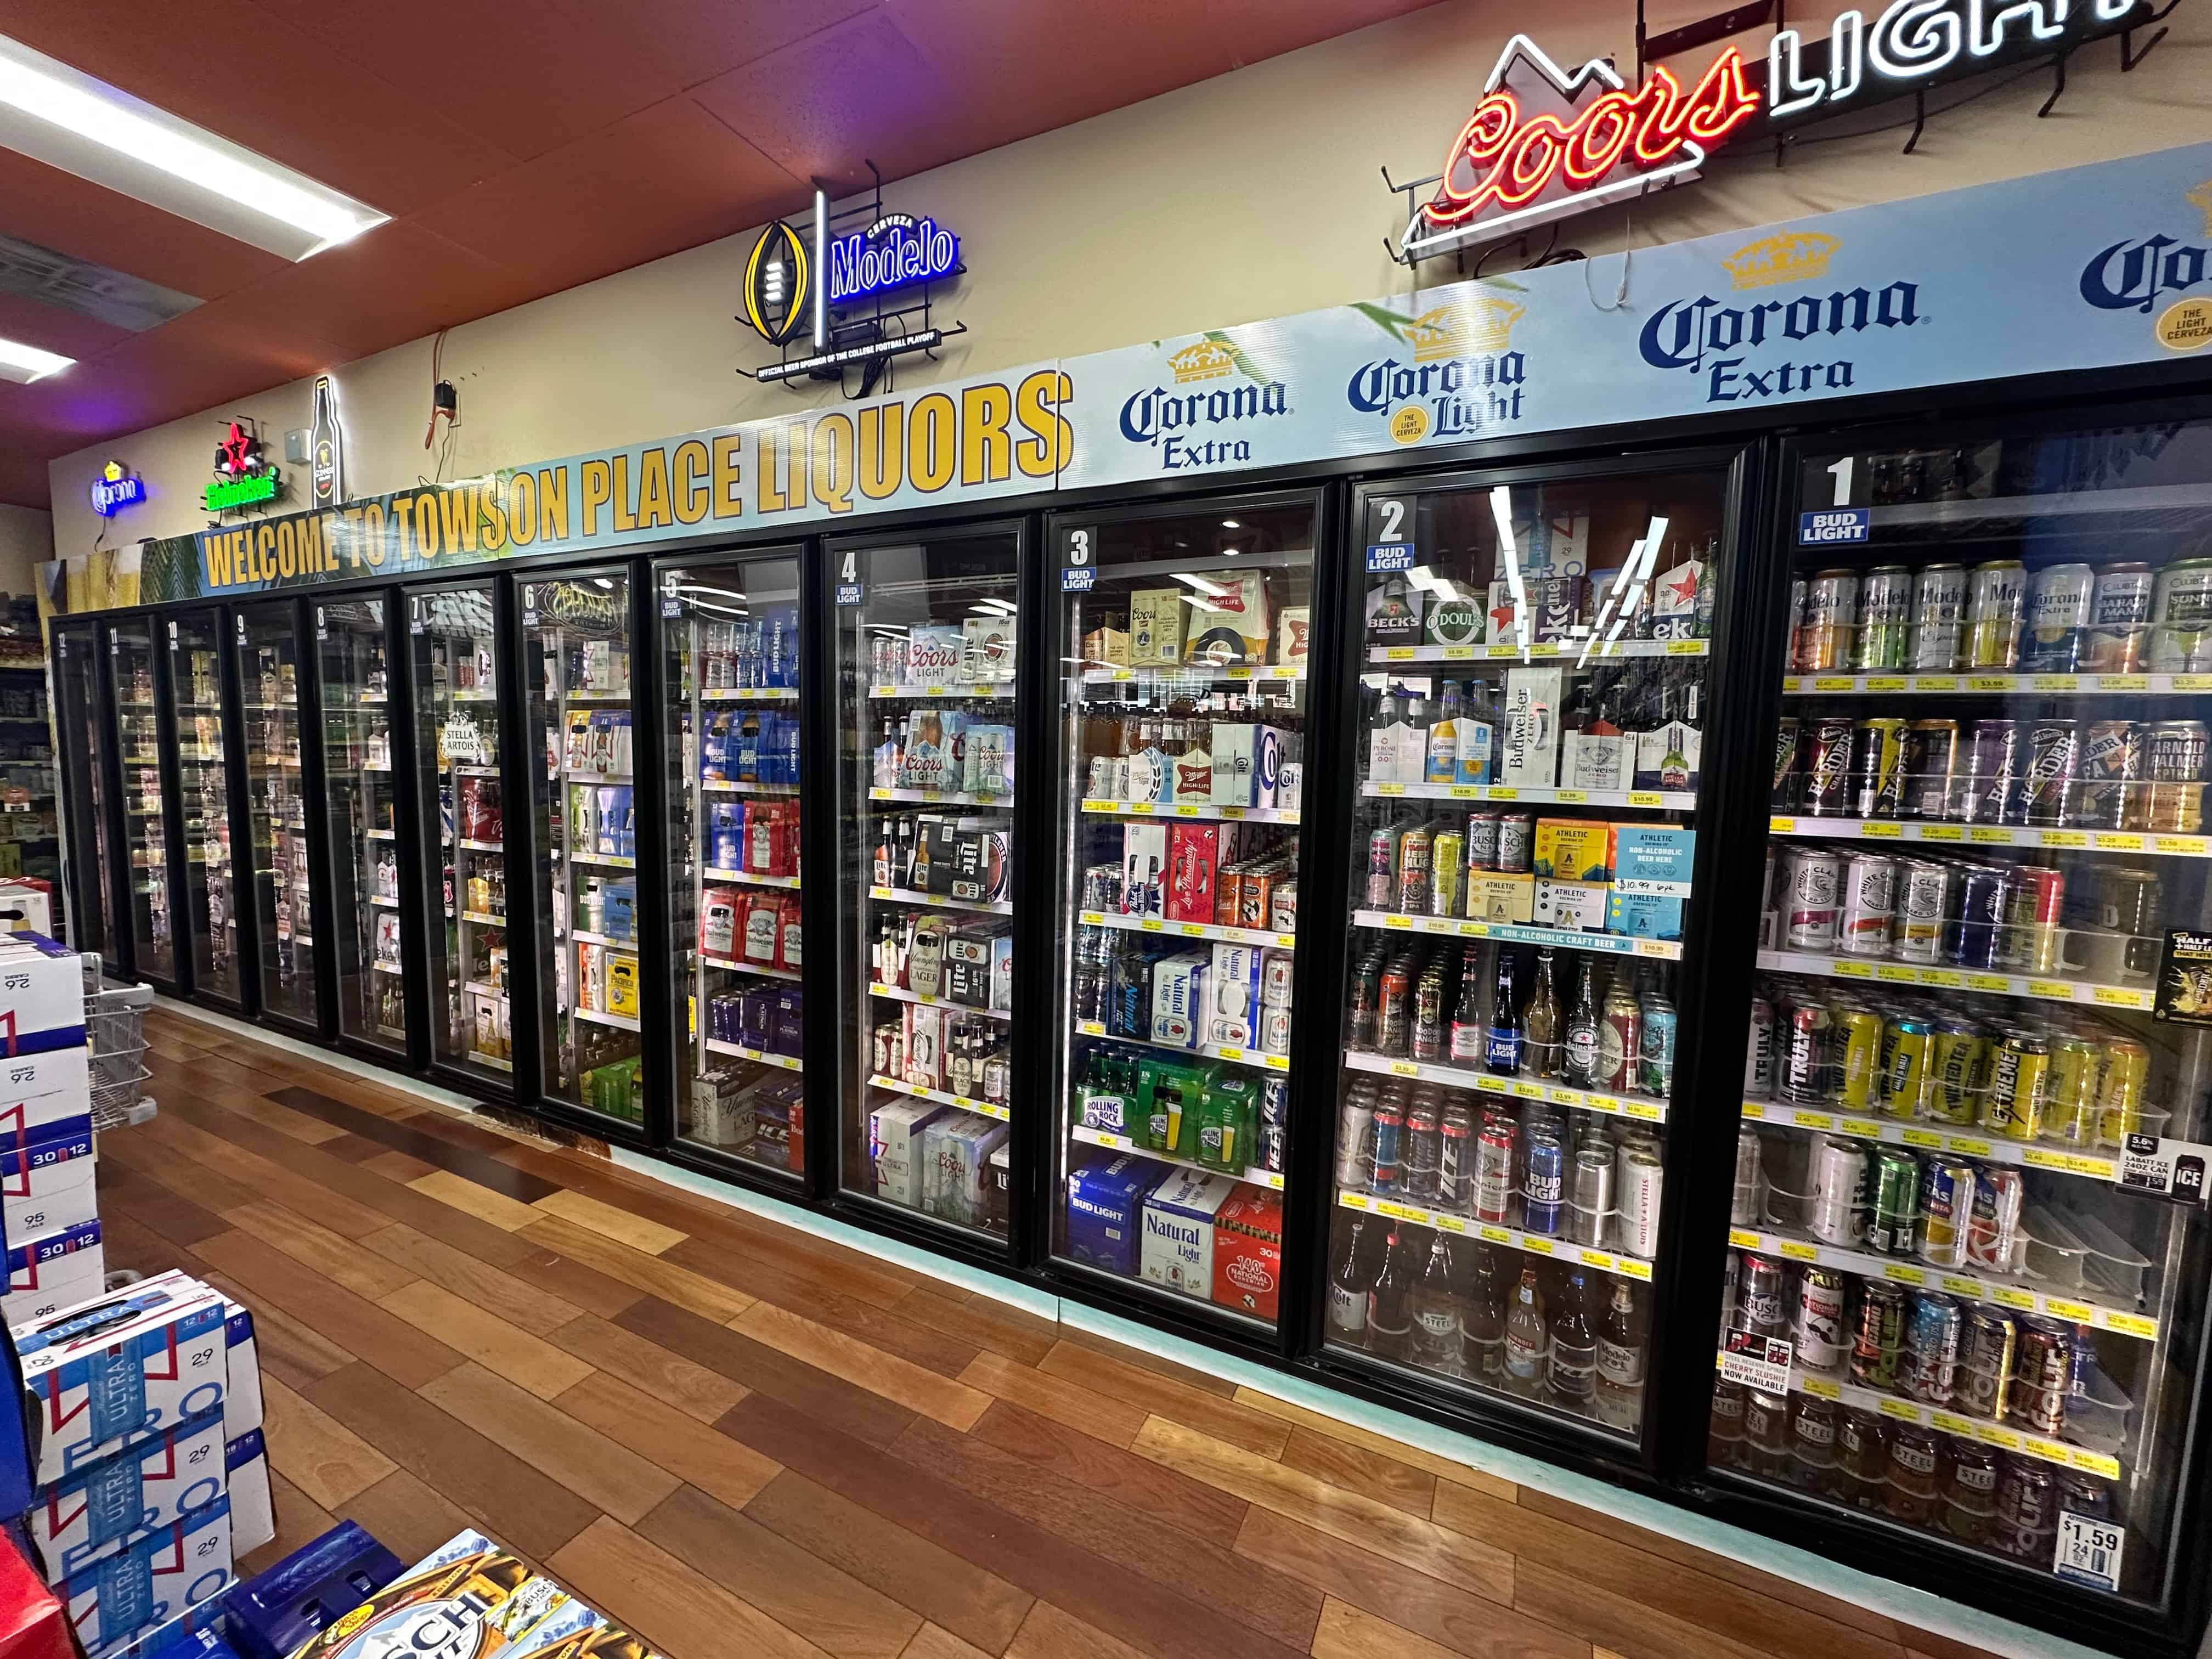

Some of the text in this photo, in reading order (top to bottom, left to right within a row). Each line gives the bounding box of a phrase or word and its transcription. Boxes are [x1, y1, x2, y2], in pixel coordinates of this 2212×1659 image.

[1424, 46, 1759, 223] Coors
[867, 216, 913, 240] CERVEZA
[830, 221, 955, 300] Modelo
[2175, 317, 2207, 330] LIGHT
[2183, 309, 2202, 319] THE
[1638, 280, 1919, 374] Corona
[758, 332, 935, 378] OFFICIAL BEER SPONSOR OF THE COLLEGE FOOTBALL PLAYOFF
[1347, 350, 1527, 416] Corona
[1706, 359, 1855, 403] Extra
[1119, 381, 1289, 447] Corona
[1431, 387, 1527, 438] Light
[1396, 427, 1421, 437] CERVEZA
[1400, 421, 1418, 430] LIGHT
[1162, 436, 1251, 470] Extra
[204, 369, 1075, 588] WELCOME TO TOWSON PLACE LIQUORS
[1826, 456, 1853, 506] 1
[205, 476, 275, 511] Heineken
[1379, 501, 1404, 543] 2
[1813, 512, 1858, 529] BUD
[1804, 523, 1865, 542] LIGHT
[1070, 530, 1088, 566] 3
[1375, 548, 1405, 561] BUD
[841, 552, 855, 583] 4
[1368, 557, 1412, 572] LIGHT
[1063, 578, 1094, 591] LIGHT
[1067, 570, 1090, 580] BUD
[665, 572, 677, 598] 5
[840, 586, 858, 596] BUD
[524, 585, 535, 610] 6
[837, 594, 861, 604] LIGHT
[318, 607, 325, 626] 8
[411, 597, 420, 619] 7
[662, 607, 681, 617] LIGHT
[1132, 607, 1156, 620] Coors
[168, 622, 178, 639] 10
[237, 614, 245, 633] 9
[1367, 615, 1420, 629] BECK'S
[110, 628, 118, 644] 11
[774, 620, 782, 651] LIGHT
[908, 644, 959, 668] Coors
[917, 668, 945, 678] LIGHT
[447, 730, 473, 740] STELLA
[1509, 689, 1527, 769] Budweiser
[447, 741, 475, 751] ARTOIS
[2153, 741, 2205, 754] ARNOLD
[905, 753, 944, 772] Coors
[1235, 757, 1249, 772] Colt
[1261, 731, 1286, 791] Colt
[1808, 733, 1855, 797] HARDER
[2152, 754, 2204, 768] PALMER
[908, 772, 939, 782] LIGHT
[1184, 770, 1208, 782] Miller
[2154, 768, 2198, 780] SPIKED
[1555, 830, 1588, 838] ATHLETIC
[959, 841, 979, 876] Lite
[1628, 847, 1683, 856] NON-ALCOHOLIC
[1486, 881, 1516, 890] ATHLETIC
[1555, 889, 1587, 898] ATHLETIC
[1616, 877, 1650, 891] $10.99
[1860, 873, 1877, 895] WHITE
[1128, 890, 1138, 910] Pabst
[1628, 894, 1662, 902] ATHLETIC
[1500, 929, 1615, 949] NON-ALCOHOLIC CRAFT BEER
[1229, 949, 1243, 980] Natural
[5, 978, 30, 990] 2.6
[910, 970, 938, 984] LAGER
[953, 963, 969, 994] Lite
[1172, 974, 1188, 1014] Natural
[1125, 983, 1137, 1034] Natural
[1492, 1049, 1517, 1058] LIGHT
[1496, 1043, 1515, 1051] BUD
[1790, 1028, 1811, 1085] TRULY
[1951, 1043, 1972, 1063] TEA
[10, 1070, 35, 1084] 2.6
[1993, 1048, 2021, 1124] EXTREME
[1087, 1101, 1119, 1114] ROLLING
[1099, 1110, 1119, 1125] ROCK
[69, 1143, 87, 1155] 12
[33, 1152, 56, 1166] 30
[2125, 1156, 2155, 1166] LABATT
[2149, 1166, 2169, 1175] CAN
[2176, 1168, 2202, 1187] ICE
[1530, 1174, 1561, 1189] BUD
[24, 1212, 45, 1224] 95
[1071, 1197, 1124, 1222] BUD LIGHT
[1146, 1212, 1200, 1246] Natural
[77, 1233, 94, 1246] 12
[41, 1244, 64, 1259] 30
[1177, 1245, 1202, 1262] Light
[1259, 1247, 1273, 1257] 30
[1231, 1267, 1268, 1284] NATIONAL
[1334, 1286, 1351, 1306] Colt
[35, 1304, 55, 1318] 95
[205, 1308, 218, 1318] 12
[1425, 1319, 1451, 1328] STEEL
[1868, 1306, 1883, 1345] CAMO
[191, 1348, 214, 1367] 29
[1601, 1342, 1631, 1362] Modelo
[129, 1362, 140, 1401] ZERO
[1724, 1361, 1786, 1384] CHERRY SLUSHIE
[1724, 1369, 1785, 1392] NOW AVAILABLE
[109, 1357, 128, 1421] ULTRA
[1796, 1419, 1831, 1438] STEEL
[189, 1444, 210, 1463] 29
[1896, 1447, 1932, 1468] STEEL
[106, 1462, 124, 1522] ULTRA
[124, 1464, 134, 1504] ZERO
[2063, 1520, 2118, 1551] $1.59
[197, 1537, 219, 1555] 29
[2072, 1543, 2088, 1555] 24
[116, 1550, 136, 1621] ULTRA
[431, 1567, 463, 1597] EDITION
